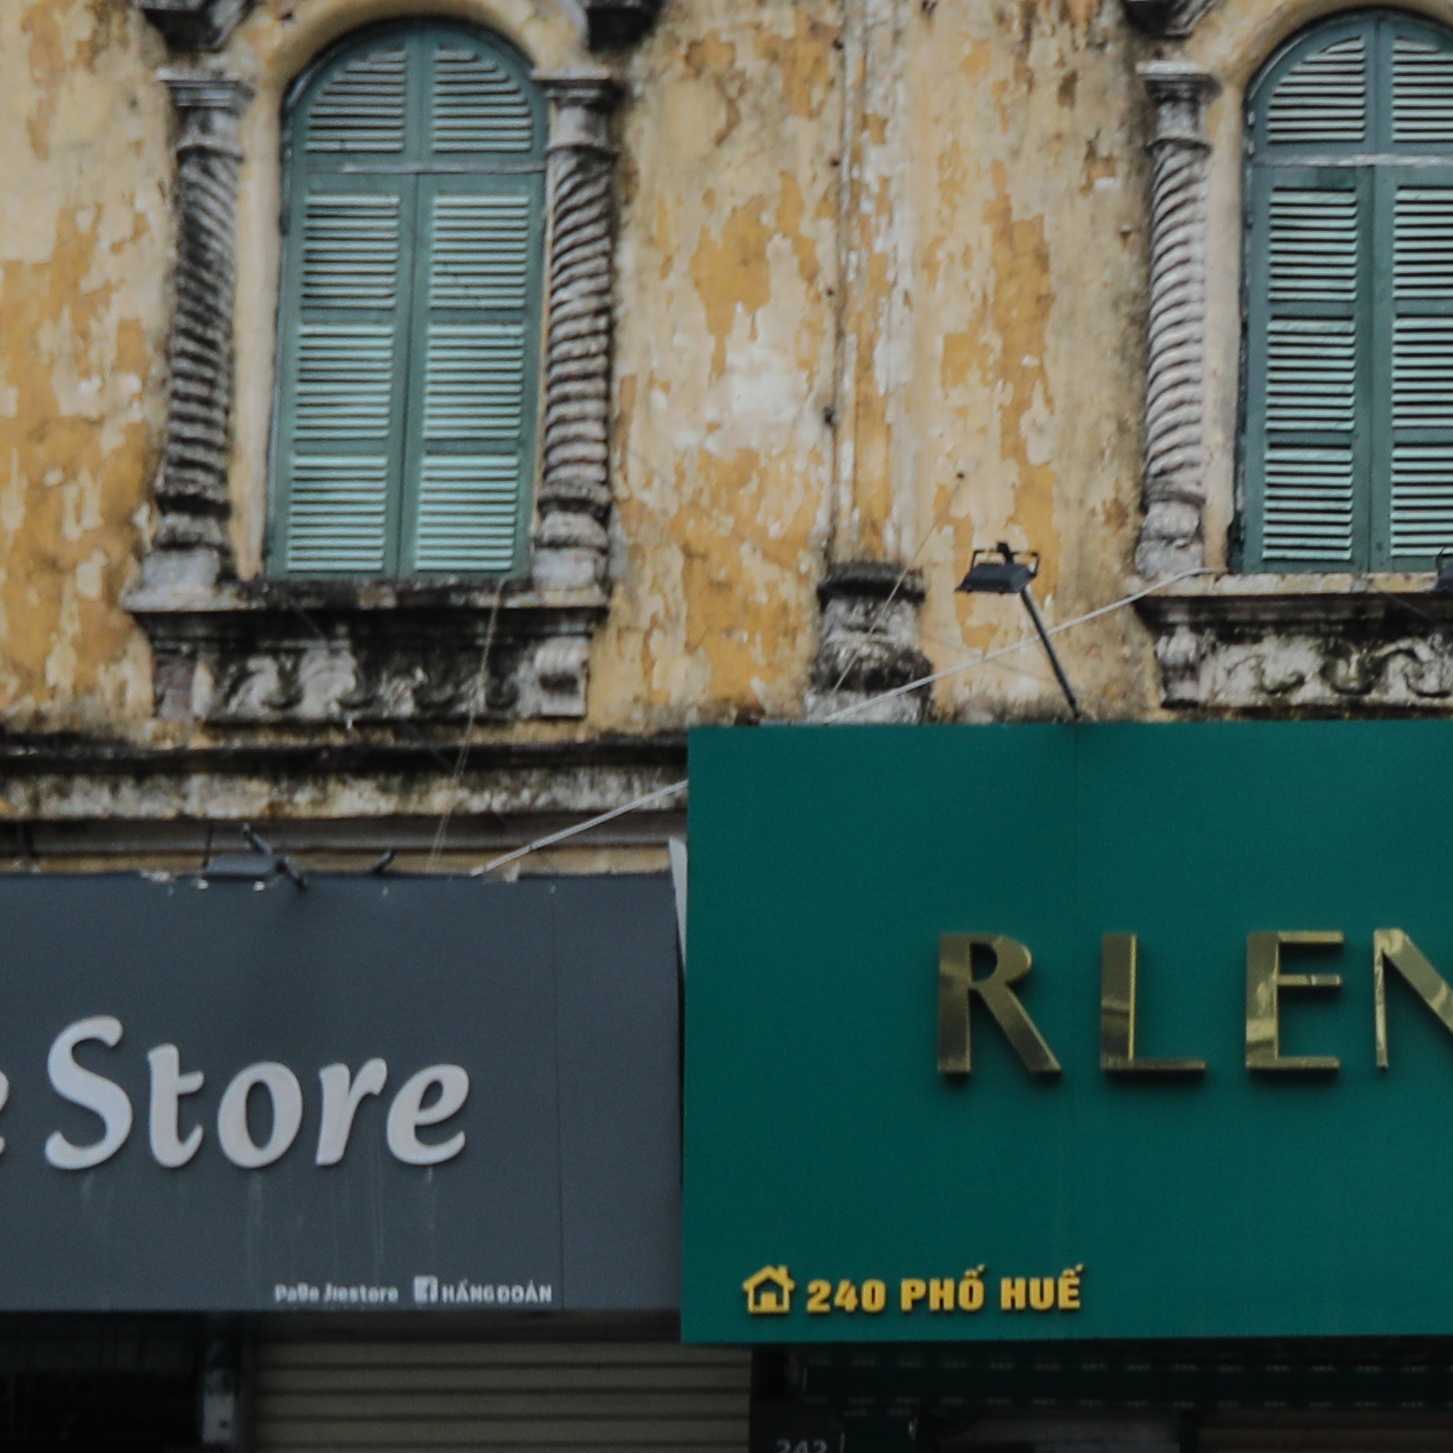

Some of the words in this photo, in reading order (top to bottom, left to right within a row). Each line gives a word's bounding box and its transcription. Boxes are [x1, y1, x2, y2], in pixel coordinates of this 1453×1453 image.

[44, 1014, 470, 1170] Store
[805, 1279, 887, 1314] 240
[900, 1263, 986, 1312] PHỐ
[1000, 1263, 1085, 1311] HUẾ
